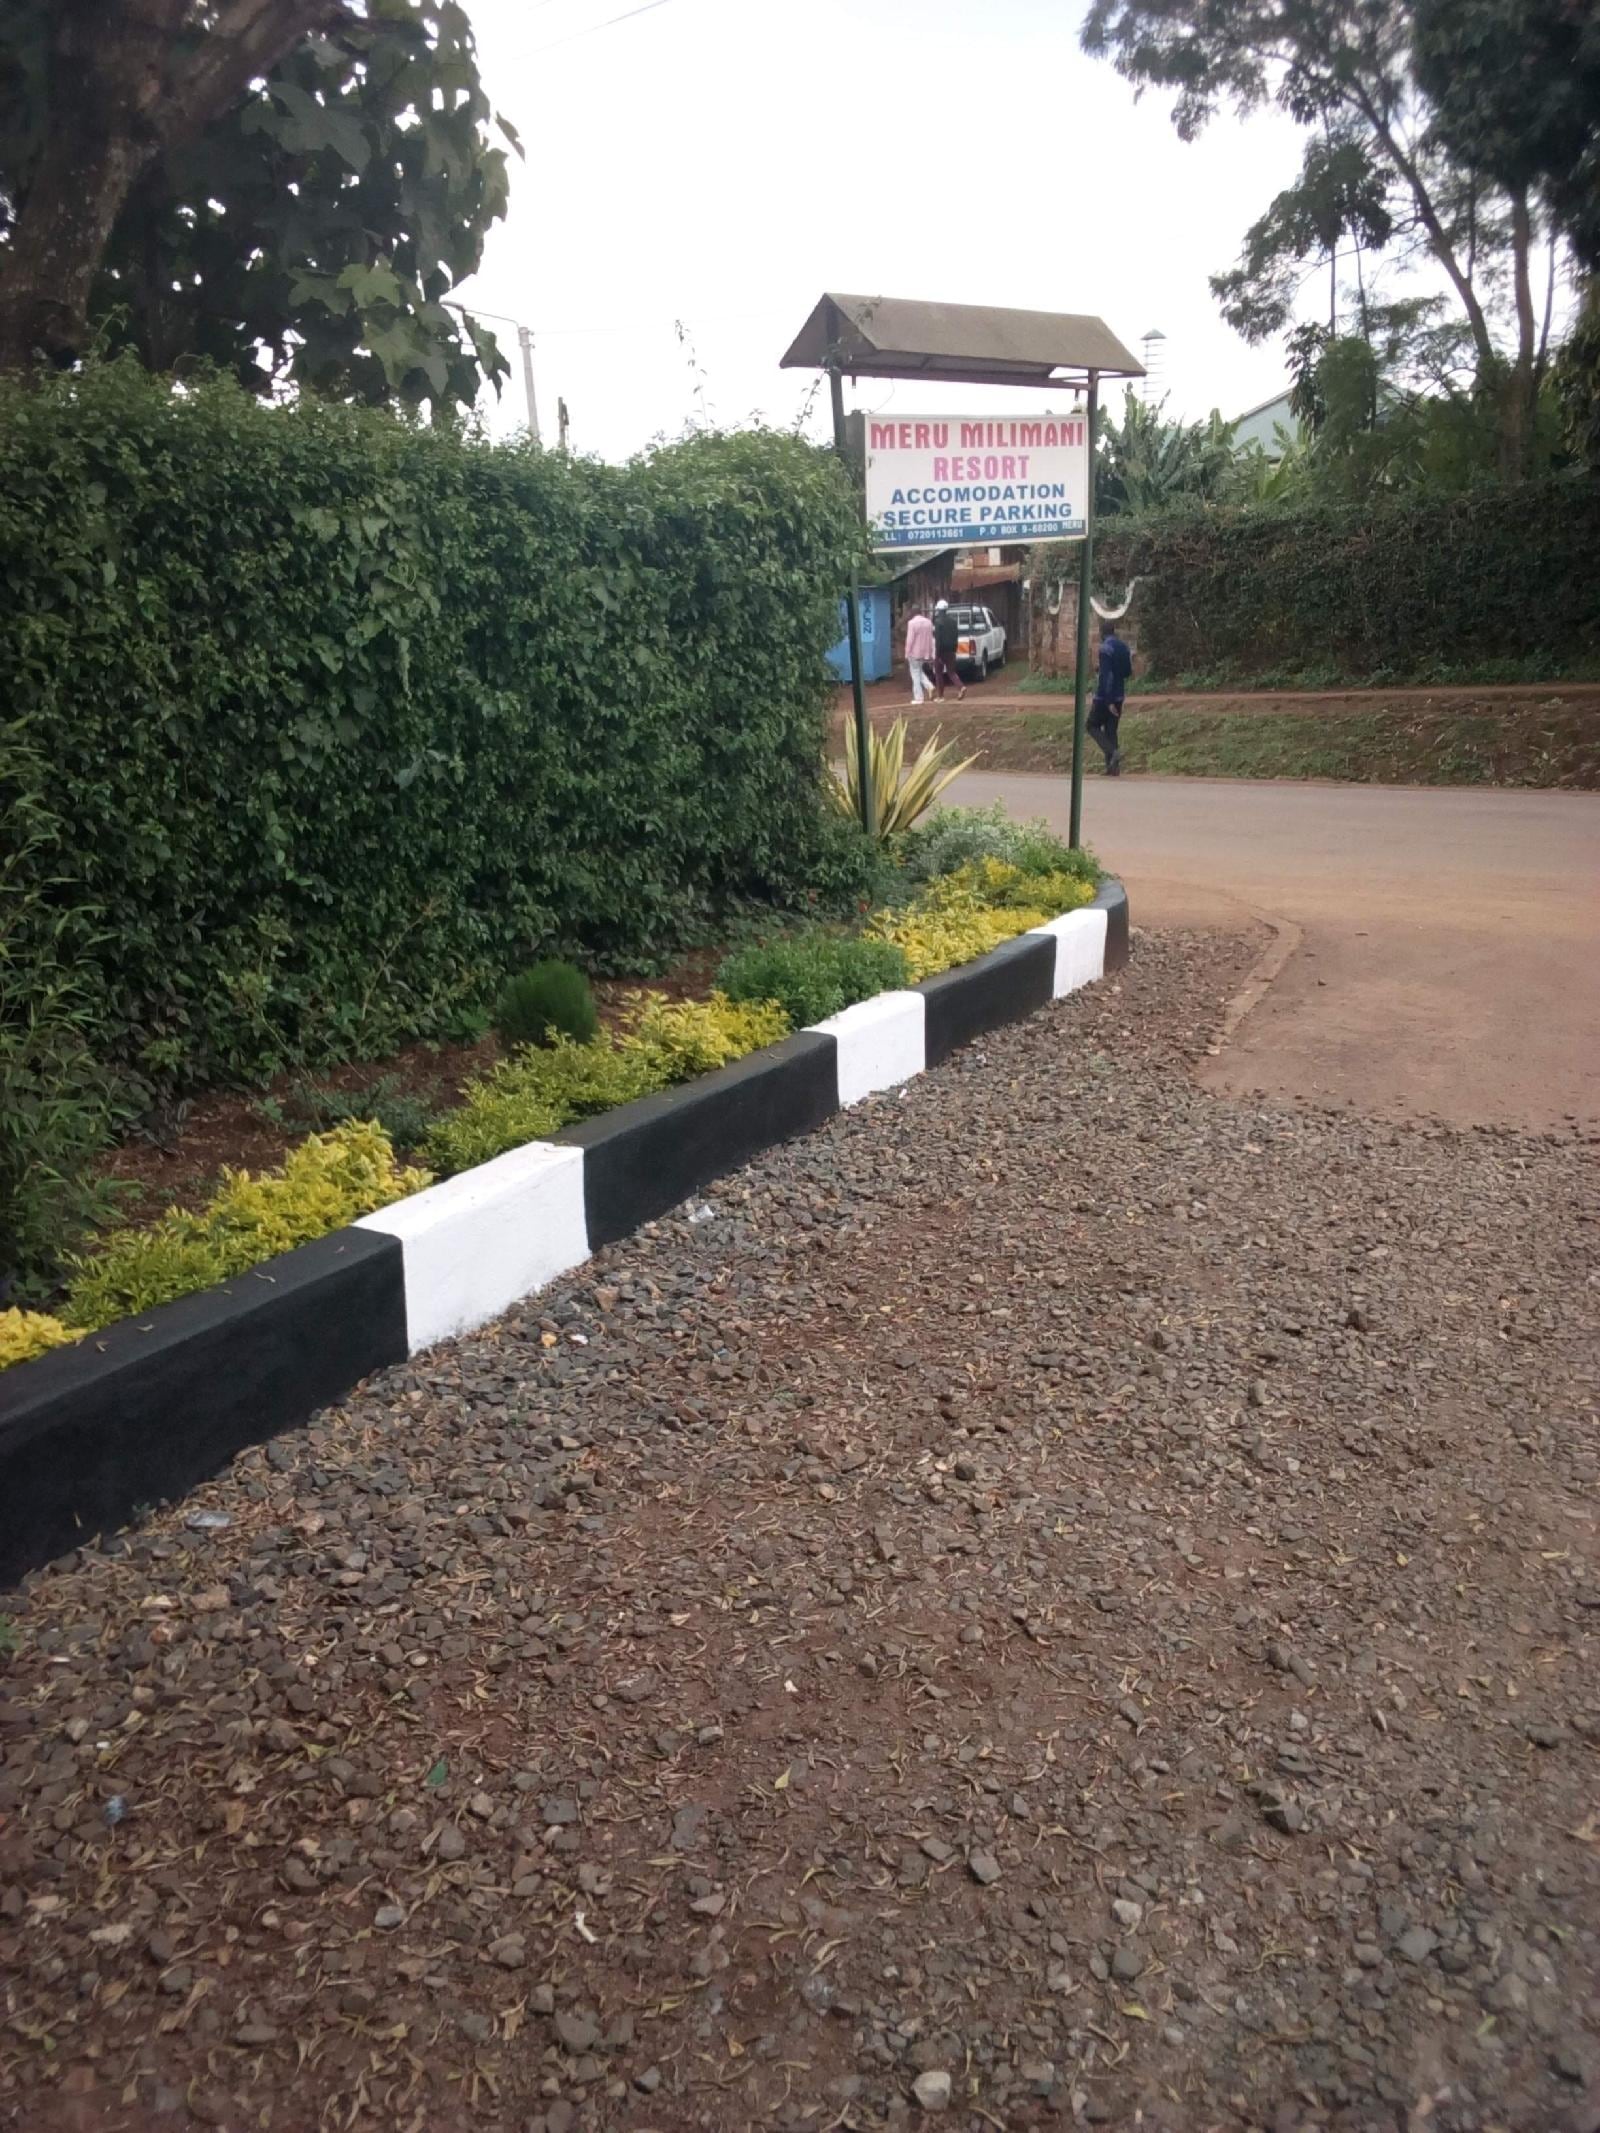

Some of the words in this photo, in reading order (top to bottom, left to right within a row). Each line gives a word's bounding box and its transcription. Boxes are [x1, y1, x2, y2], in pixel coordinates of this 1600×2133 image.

[870, 422, 949, 449] MERU
[961, 422, 1083, 448] MILIMANI
[934, 455, 1030, 482] RESORT
[891, 484, 1065, 505] ACCOMODATION
[883, 507, 972, 527] SECURE
[980, 503, 1072, 522] PARKING
[1001, 525, 1018, 534] BOX
[1062, 520, 1083, 530] MERU
